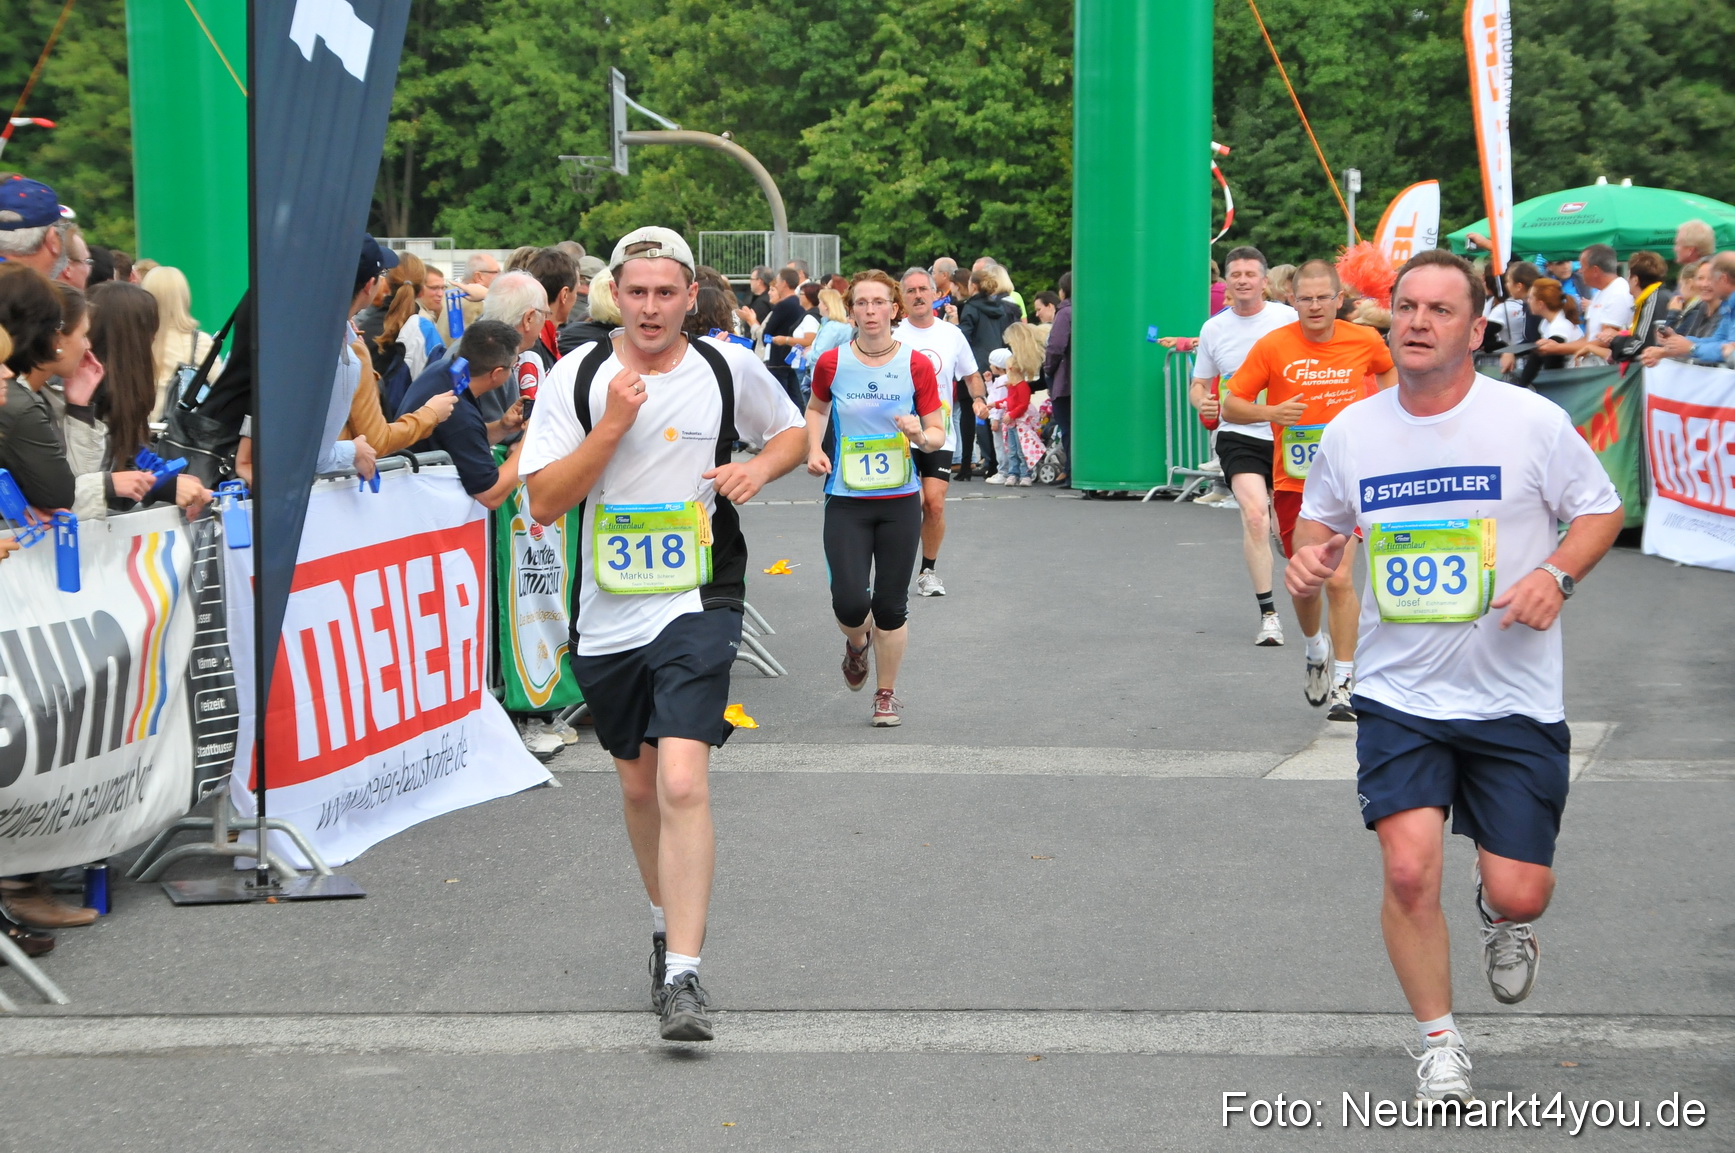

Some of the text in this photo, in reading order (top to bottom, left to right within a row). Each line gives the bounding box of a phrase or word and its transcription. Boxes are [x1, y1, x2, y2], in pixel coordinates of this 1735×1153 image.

[1295, 367, 1353, 380] Fischer
[859, 453, 890, 475] 13
[607, 534, 686, 571] 318
[620, 572, 654, 580] Markus
[1386, 555, 1468, 597] 893
[1396, 598, 1421, 607] Josef
[282, 547, 479, 762] MEIER
